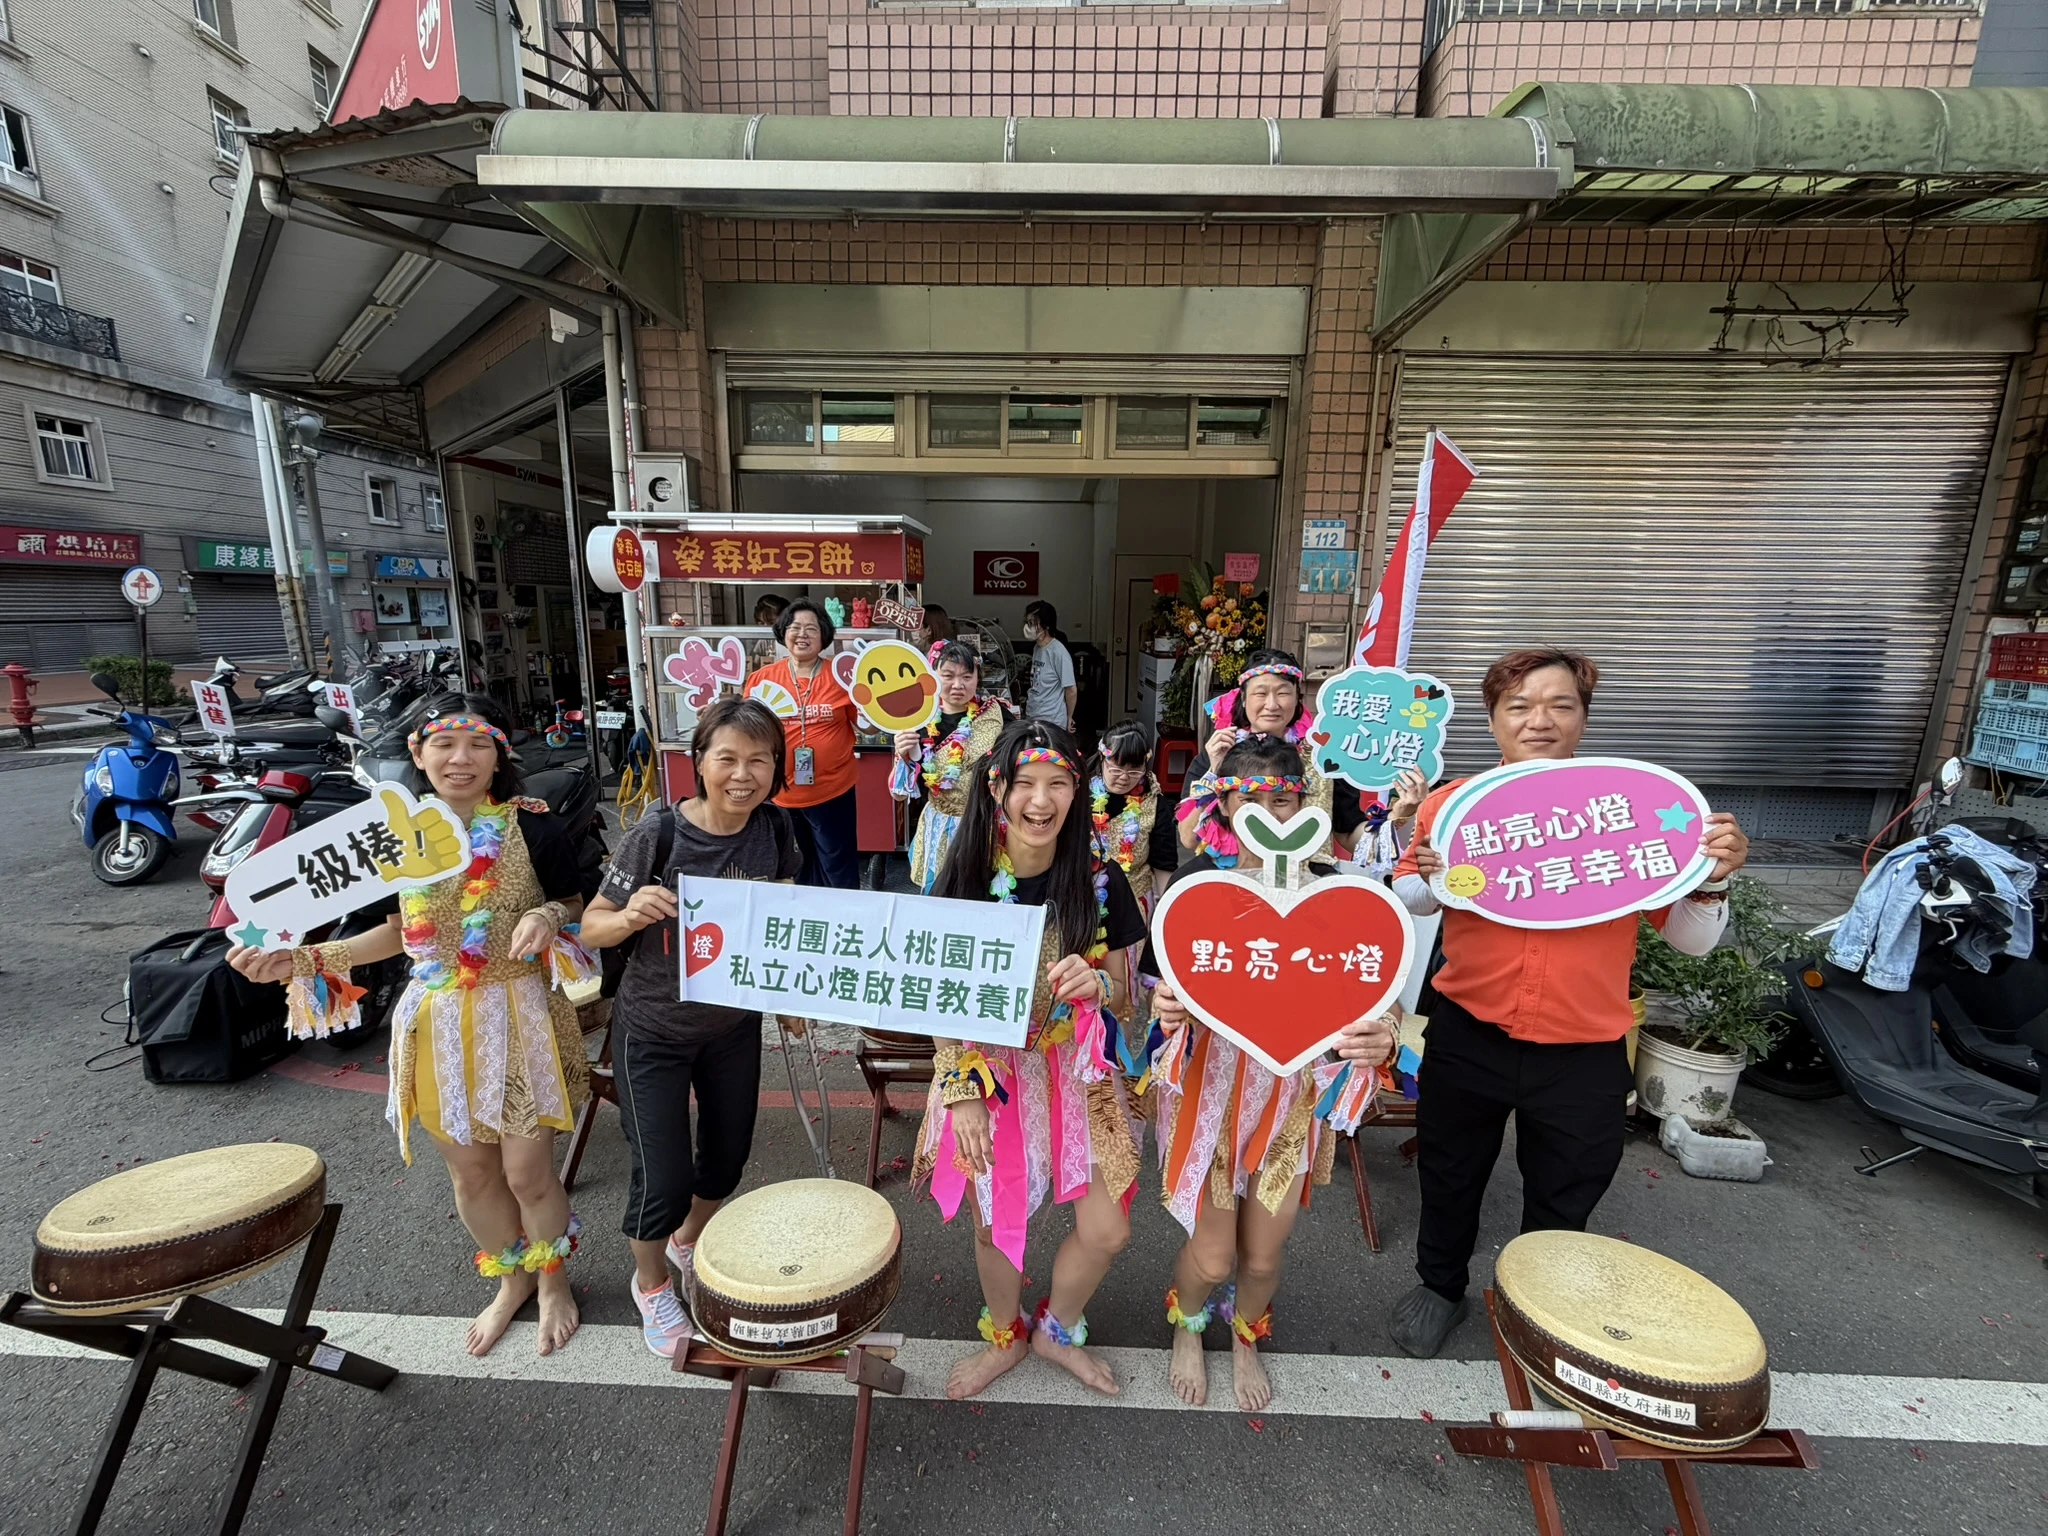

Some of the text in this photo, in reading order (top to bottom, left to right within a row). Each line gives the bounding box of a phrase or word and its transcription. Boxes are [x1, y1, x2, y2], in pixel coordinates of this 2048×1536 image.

[517, 467, 536, 483] SYM
[1315, 532, 1339, 547] 112
[87, 551, 136, 560] 4031663
[984, 580, 1027, 589] KYMCO
[1315, 569, 1356, 592] 112
[880, 605, 918, 628] OPEN
[201, 686, 227, 725] 出售
[1332, 689, 1392, 725] 我愛
[1340, 724, 1425, 770] 心燈
[1460, 793, 1636, 859] 點亮心燈
[1496, 838, 1680, 901] 分享幸福
[692, 934, 715, 960] 燈
[764, 916, 1016, 974] 財團法人桃園市
[1190, 937, 1384, 983] 點亮心燈
[733, 1318, 835, 1341] 桃園縣政府補助
[1559, 1364, 1691, 1421] 桃園縣政府補助
